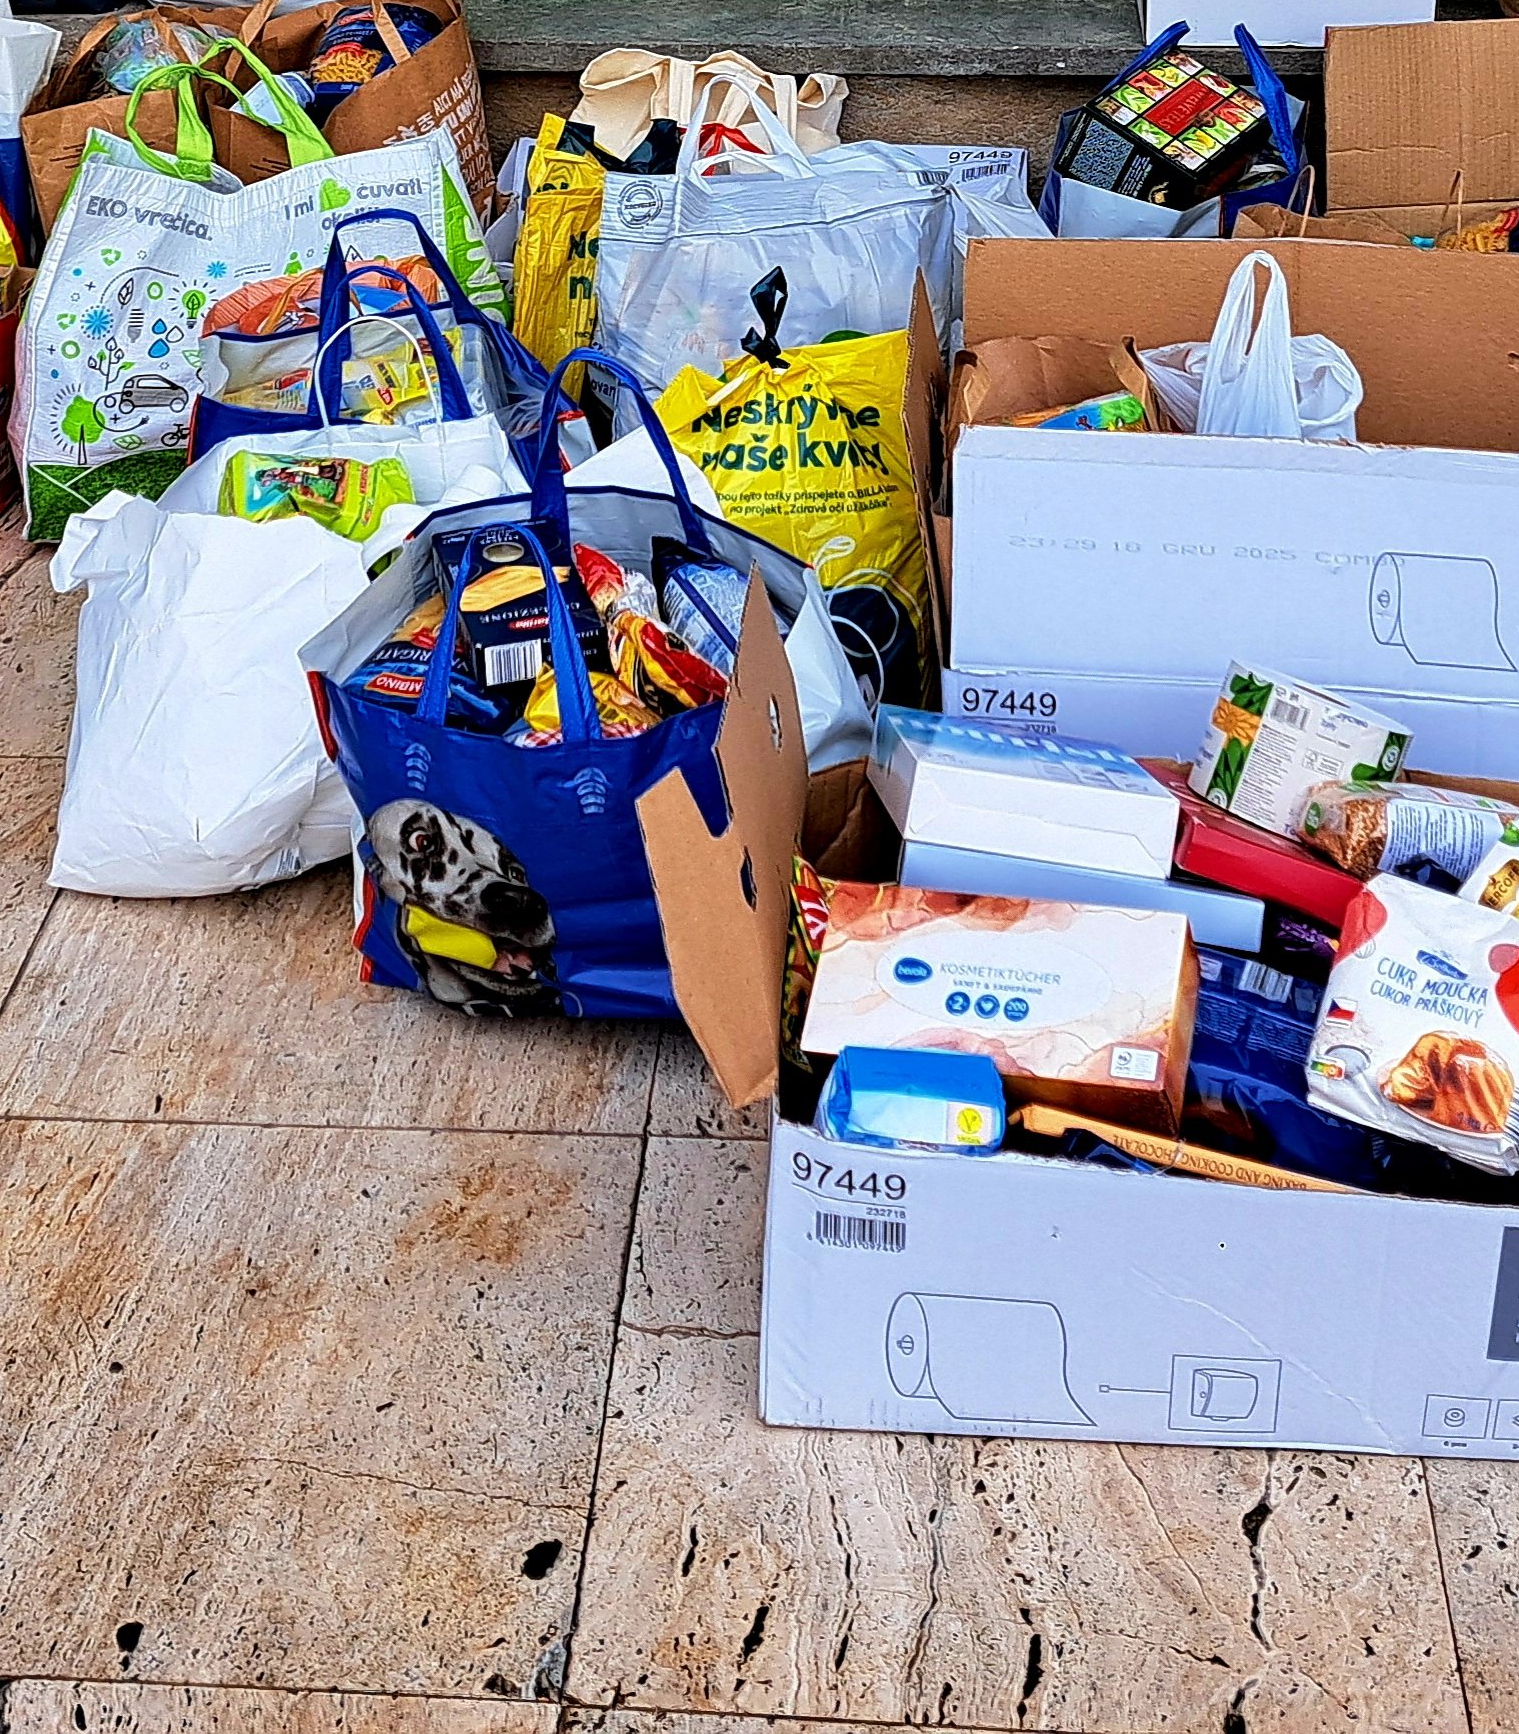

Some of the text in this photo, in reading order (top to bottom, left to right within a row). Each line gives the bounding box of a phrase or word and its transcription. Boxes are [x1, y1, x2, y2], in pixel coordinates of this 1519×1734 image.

[85, 196, 127, 220] EKO
[295, 195, 314, 217] mi
[794, 489, 846, 501] prispejete
[858, 486, 883, 498] BILLA
[730, 504, 742, 514] na
[745, 502, 782, 515] projekt
[1161, 543, 1216, 557] GRU
[1234, 546, 1298, 561] 2025
[961, 687, 1058, 717] 97449
[940, 962, 1062, 986] KOSMETIKTÜCHER
[1377, 956, 1418, 991] CUKR
[1421, 979, 1489, 1007] MOUČKA
[1370, 979, 1484, 1029] CUKOR PRÁŠKOVÝ
[792, 1151, 907, 1201] 97449
[1182, 1151, 1233, 1177] COOKING
[1235, 1169, 1260, 1184] AND
[865, 1206, 907, 1219] 232718
